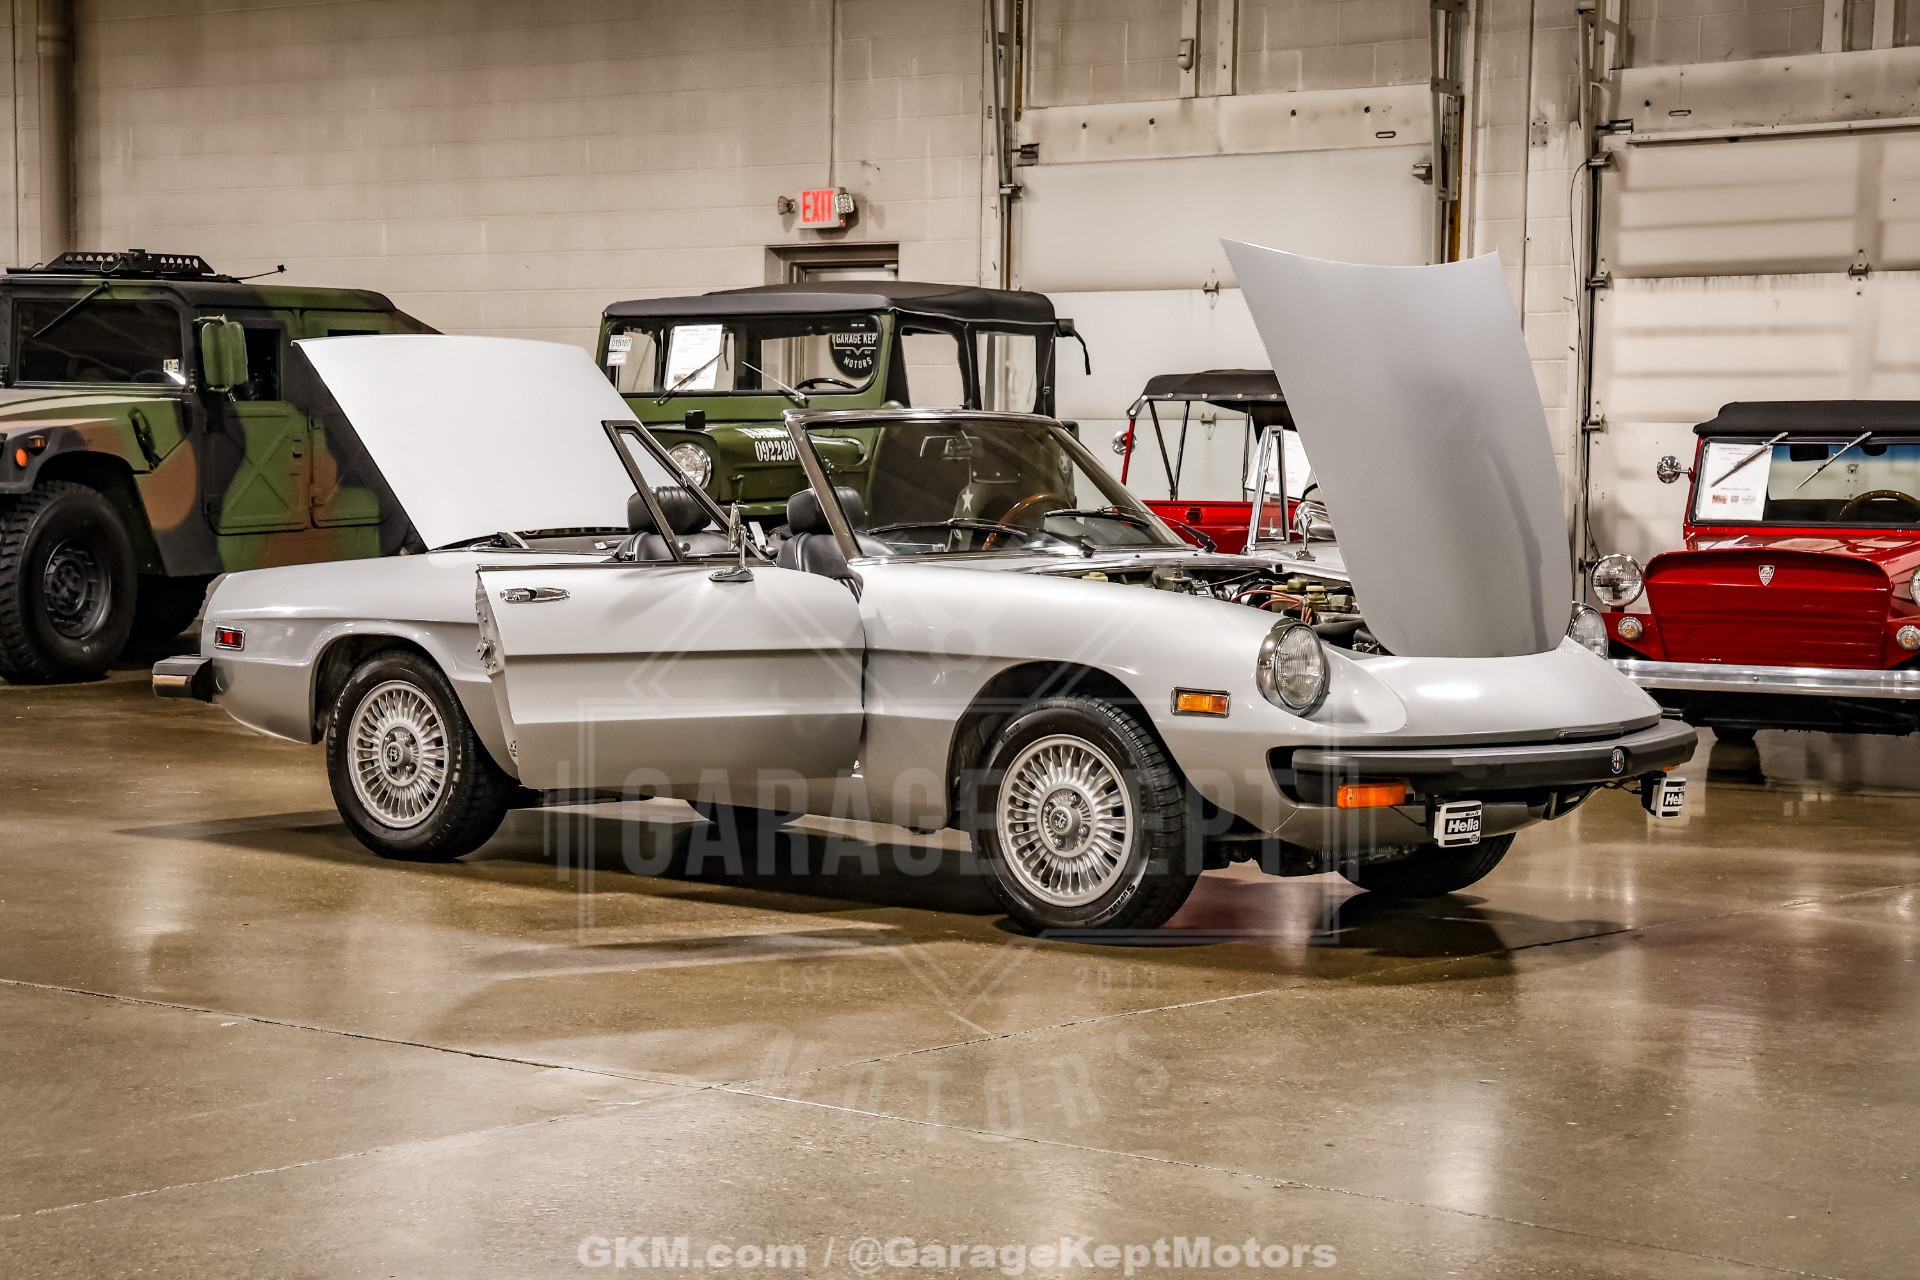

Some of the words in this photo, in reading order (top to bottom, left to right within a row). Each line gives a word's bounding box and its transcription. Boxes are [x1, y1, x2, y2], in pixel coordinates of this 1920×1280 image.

[802, 190, 835, 223] EXIT
[836, 333, 861, 344] GARAGE
[844, 356, 872, 369] MOTORS
[755, 440, 796, 462] 092280
[1447, 818, 1479, 833] Hella
